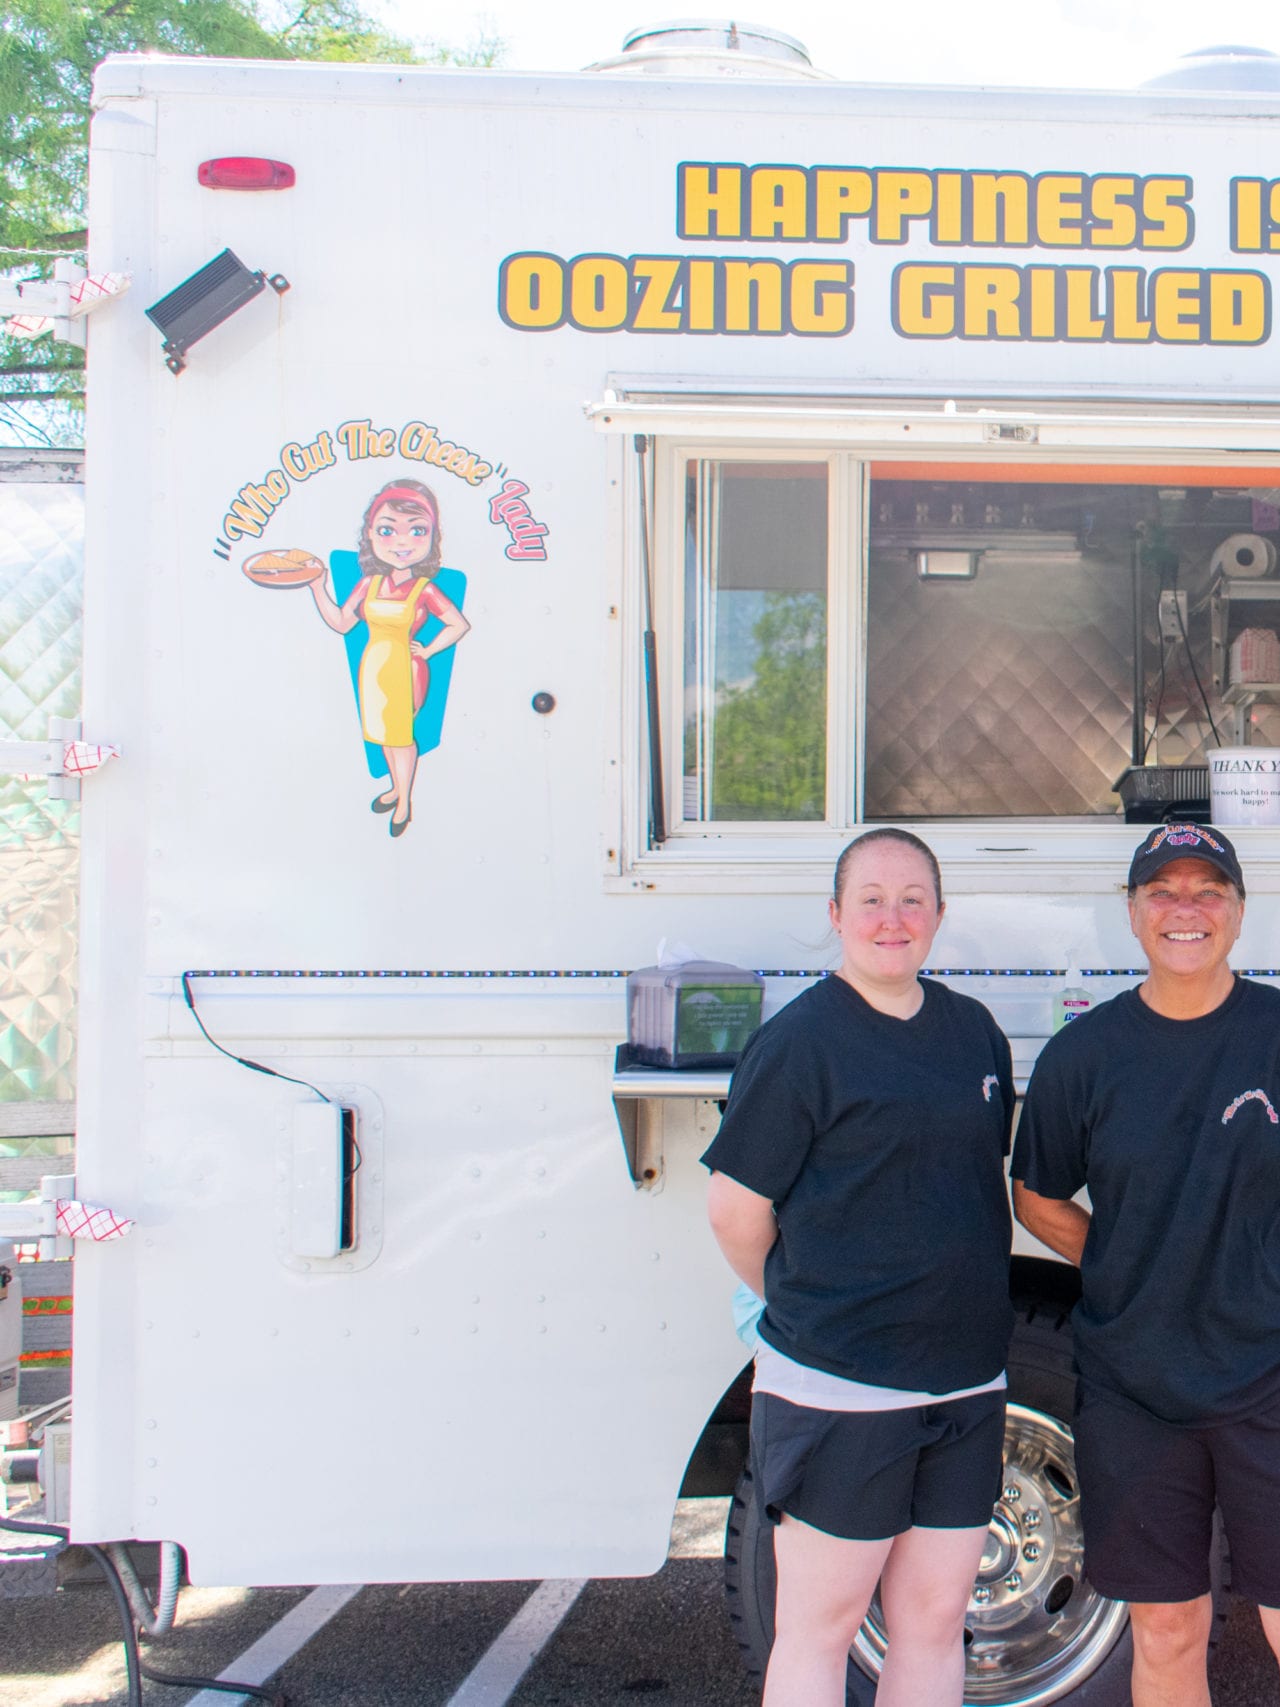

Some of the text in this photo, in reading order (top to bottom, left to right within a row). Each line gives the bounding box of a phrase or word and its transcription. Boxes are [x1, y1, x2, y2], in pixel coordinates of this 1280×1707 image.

[677, 162, 1194, 252] HAPPINESS
[498, 252, 855, 338] OOZING
[892, 262, 1272, 347] GRILLED
[280, 431, 336, 481] Cut
[338, 419, 396, 459] The
[489, 479, 549, 561] Lady
[1213, 760, 1265, 771] THANK
